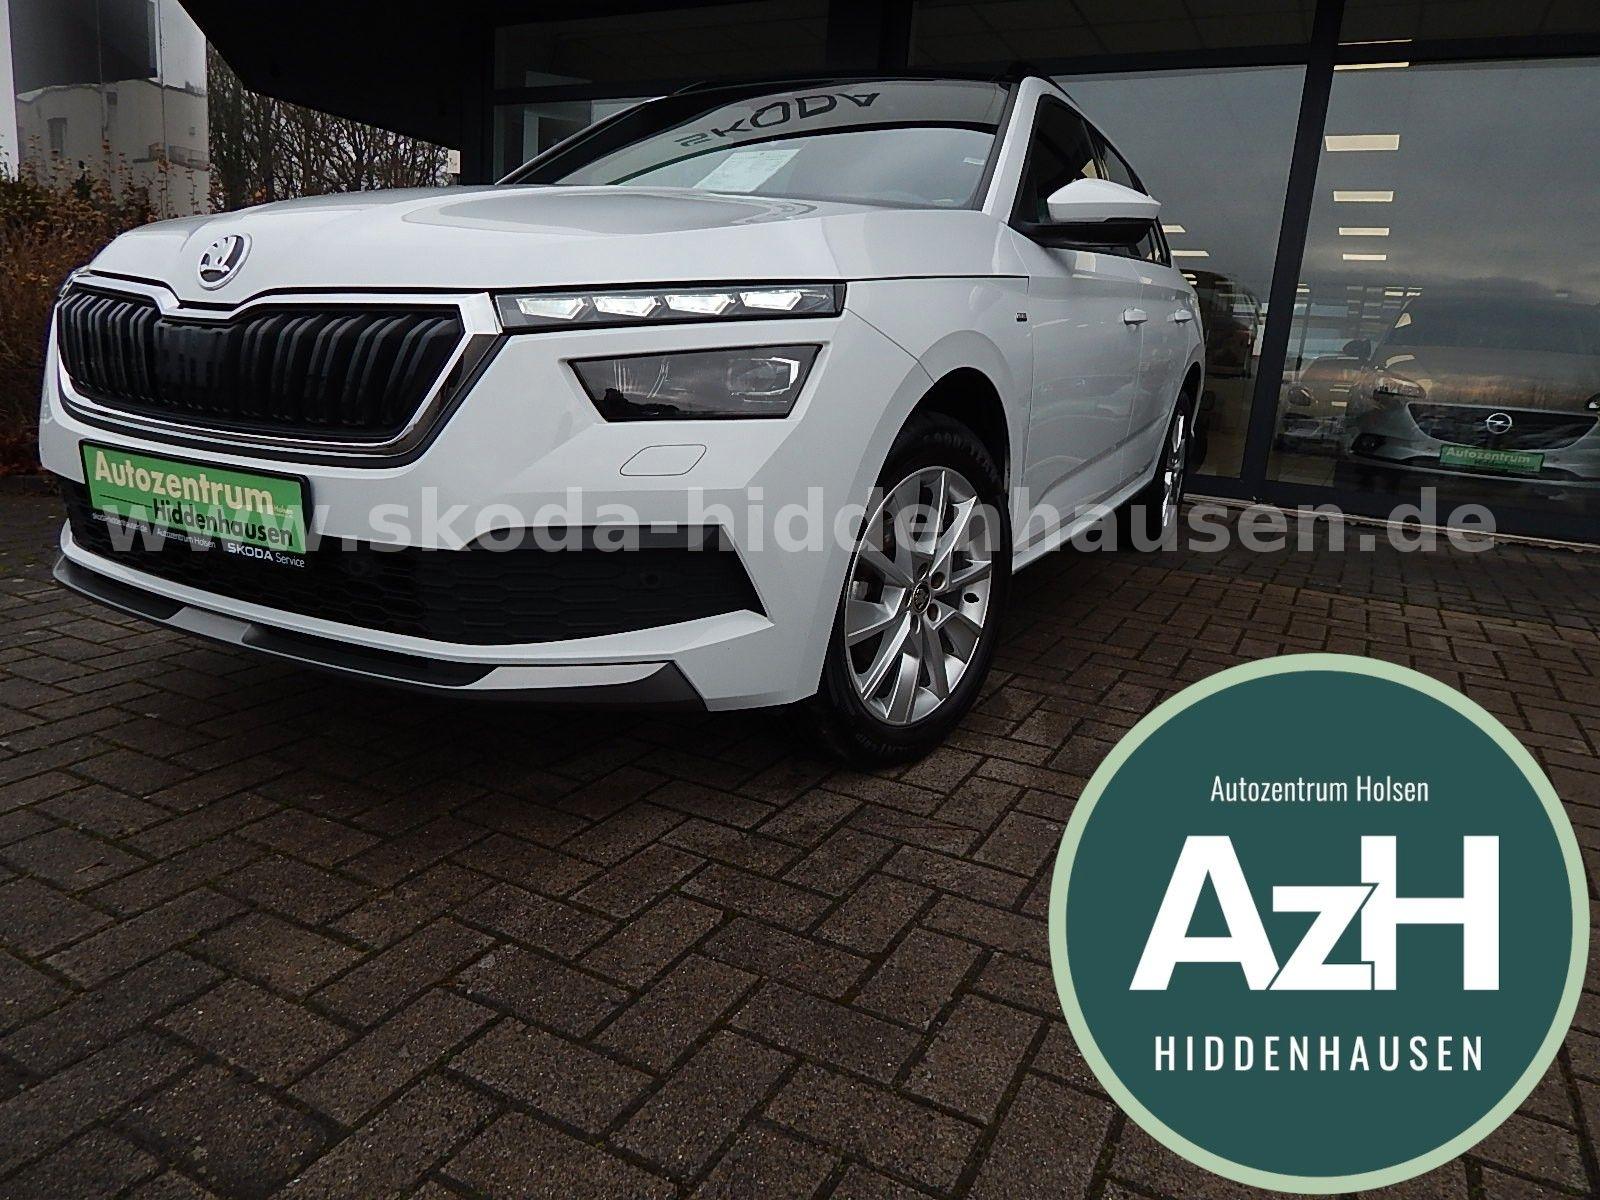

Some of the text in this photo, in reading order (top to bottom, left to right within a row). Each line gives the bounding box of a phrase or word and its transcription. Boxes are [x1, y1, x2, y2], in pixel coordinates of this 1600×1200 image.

[1446, 447, 1530, 463] Autozentrum
[95, 450, 274, 516] Autozentrum
[153, 498, 293, 547] Hiddenhausen
[227, 542, 305, 568] SKODA Service
